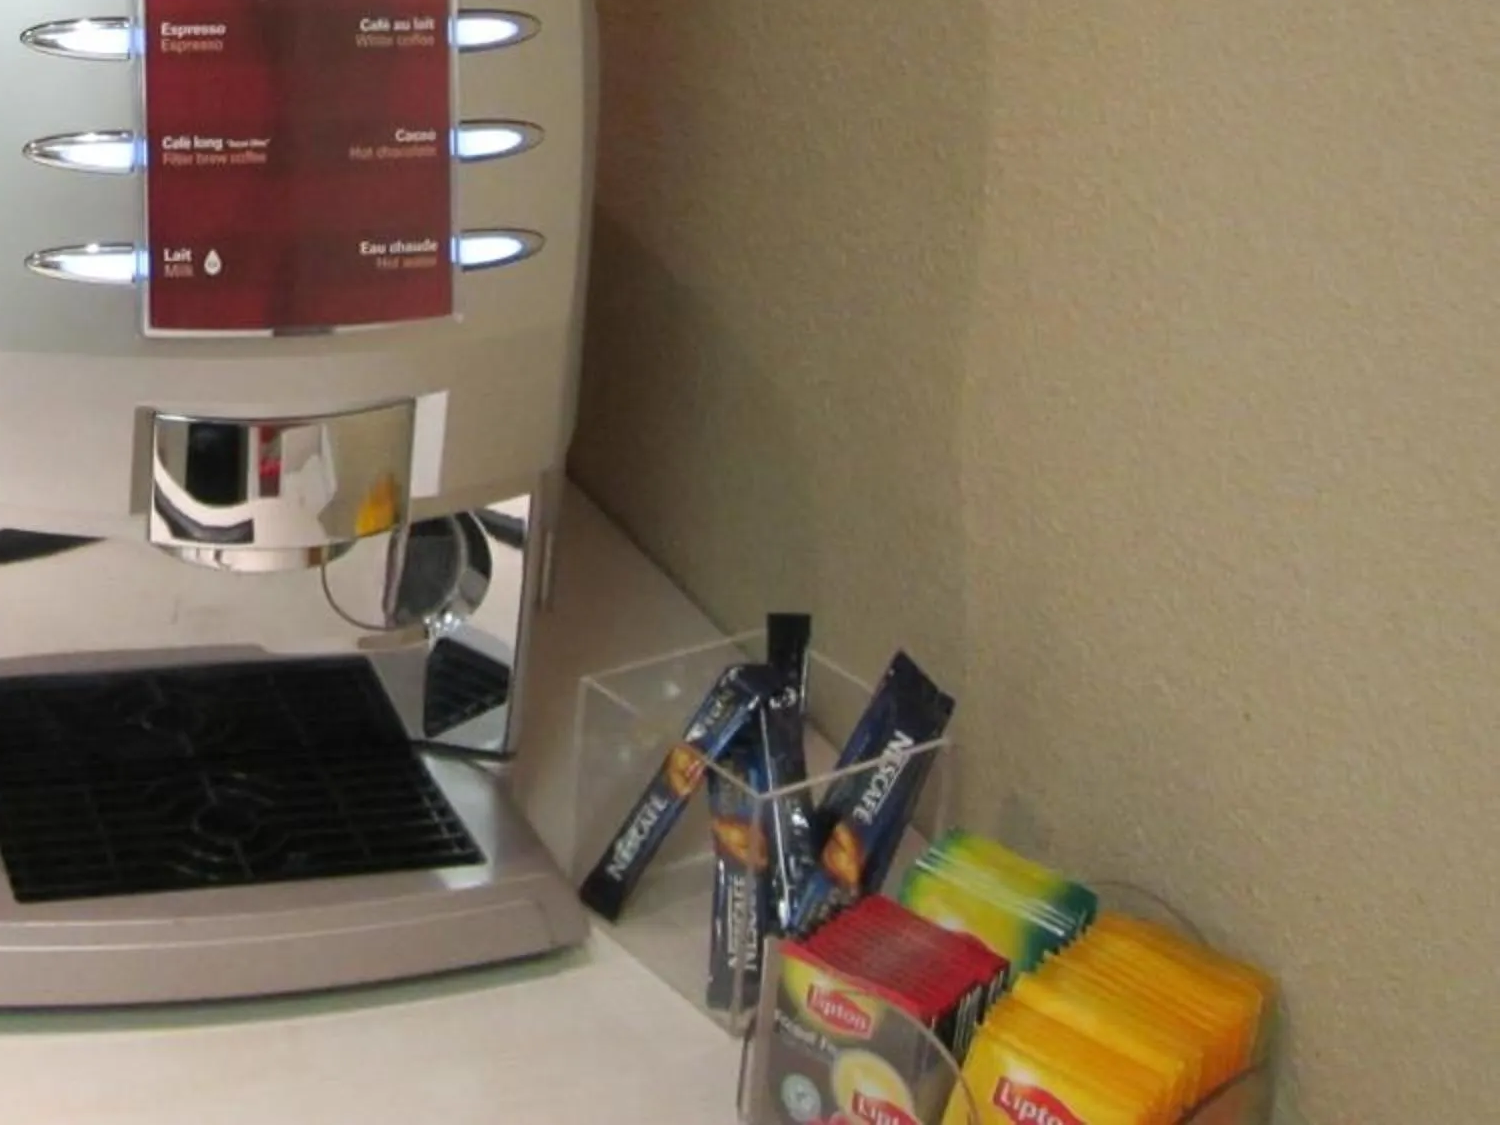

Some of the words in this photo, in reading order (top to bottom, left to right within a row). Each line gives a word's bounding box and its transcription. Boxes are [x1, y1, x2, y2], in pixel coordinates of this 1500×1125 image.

[161, 22, 227, 39] Espresso
[161, 38, 224, 55] Espresso
[163, 247, 192, 262] Lait
[359, 240, 387, 256] Eau
